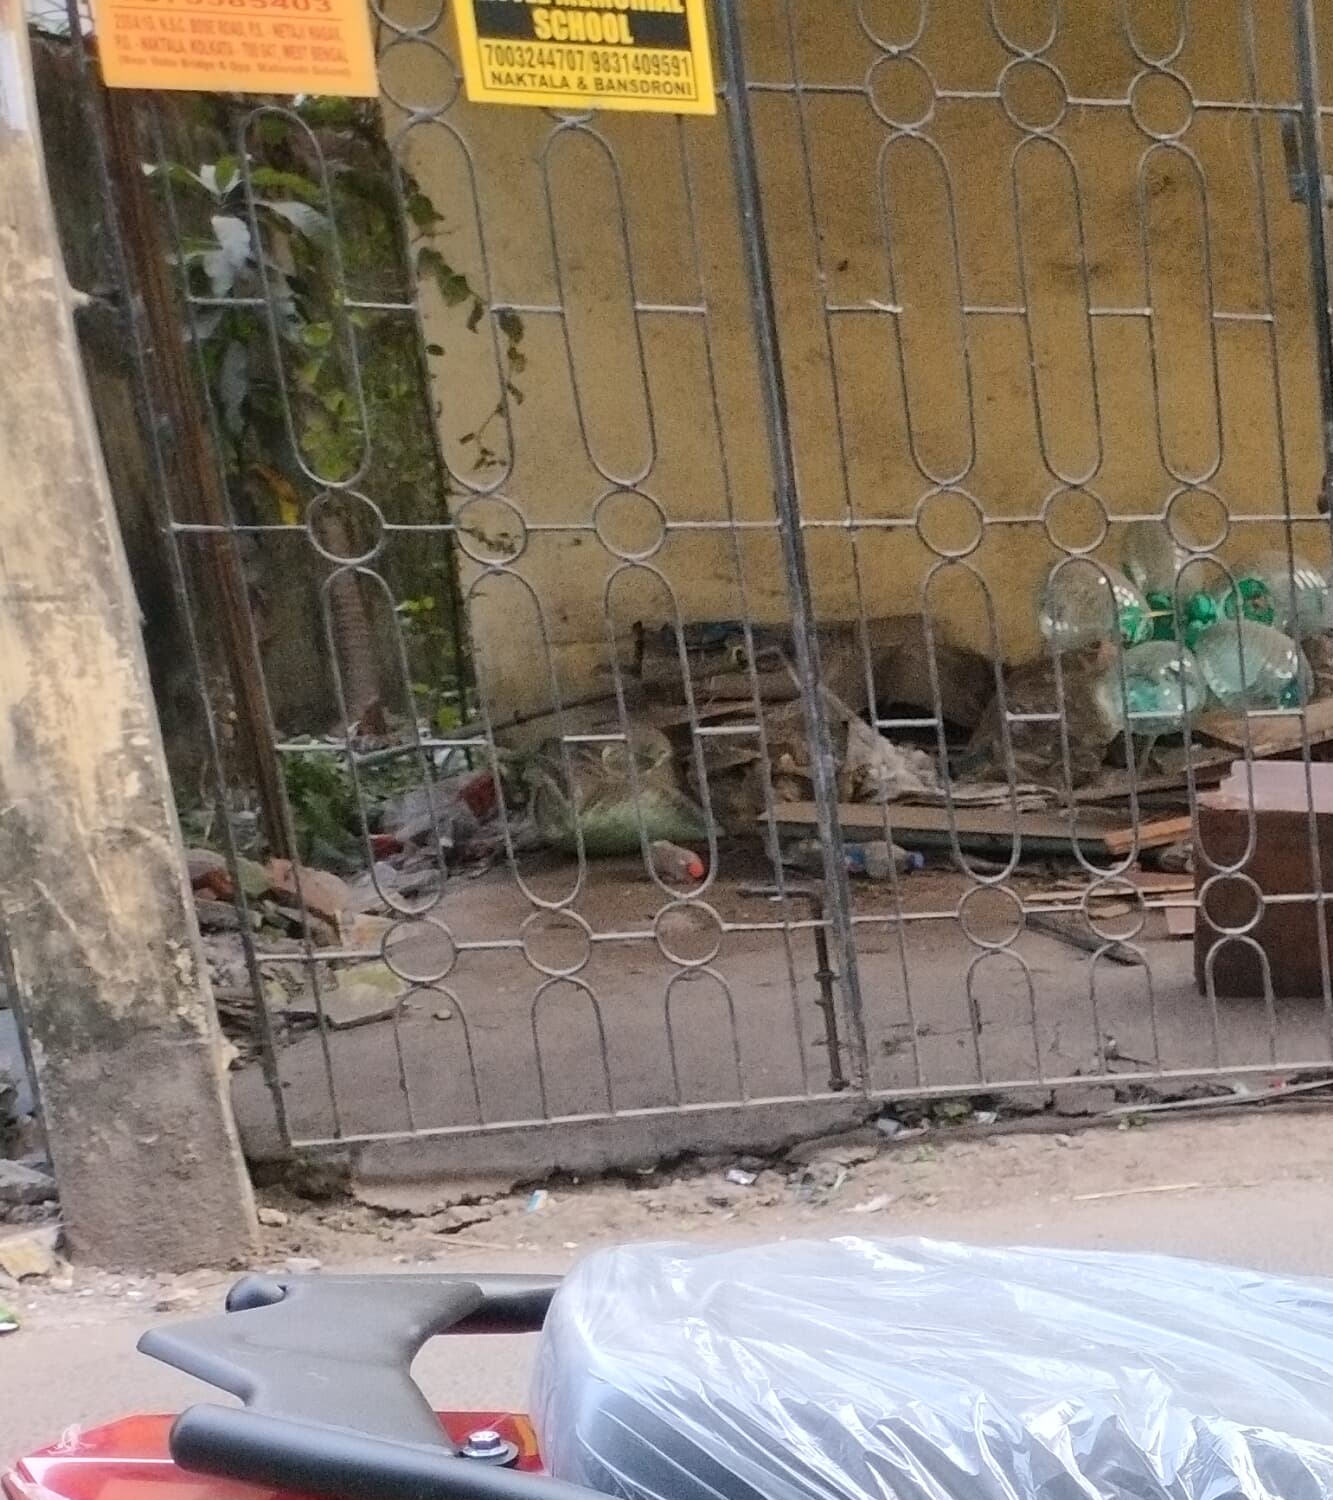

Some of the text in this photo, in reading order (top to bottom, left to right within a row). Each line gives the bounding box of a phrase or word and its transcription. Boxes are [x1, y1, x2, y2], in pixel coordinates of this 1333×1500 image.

[532, 7, 635, 45] SCHOOL
[491, 72, 693, 96] NAKTALA & BANSDRONI
